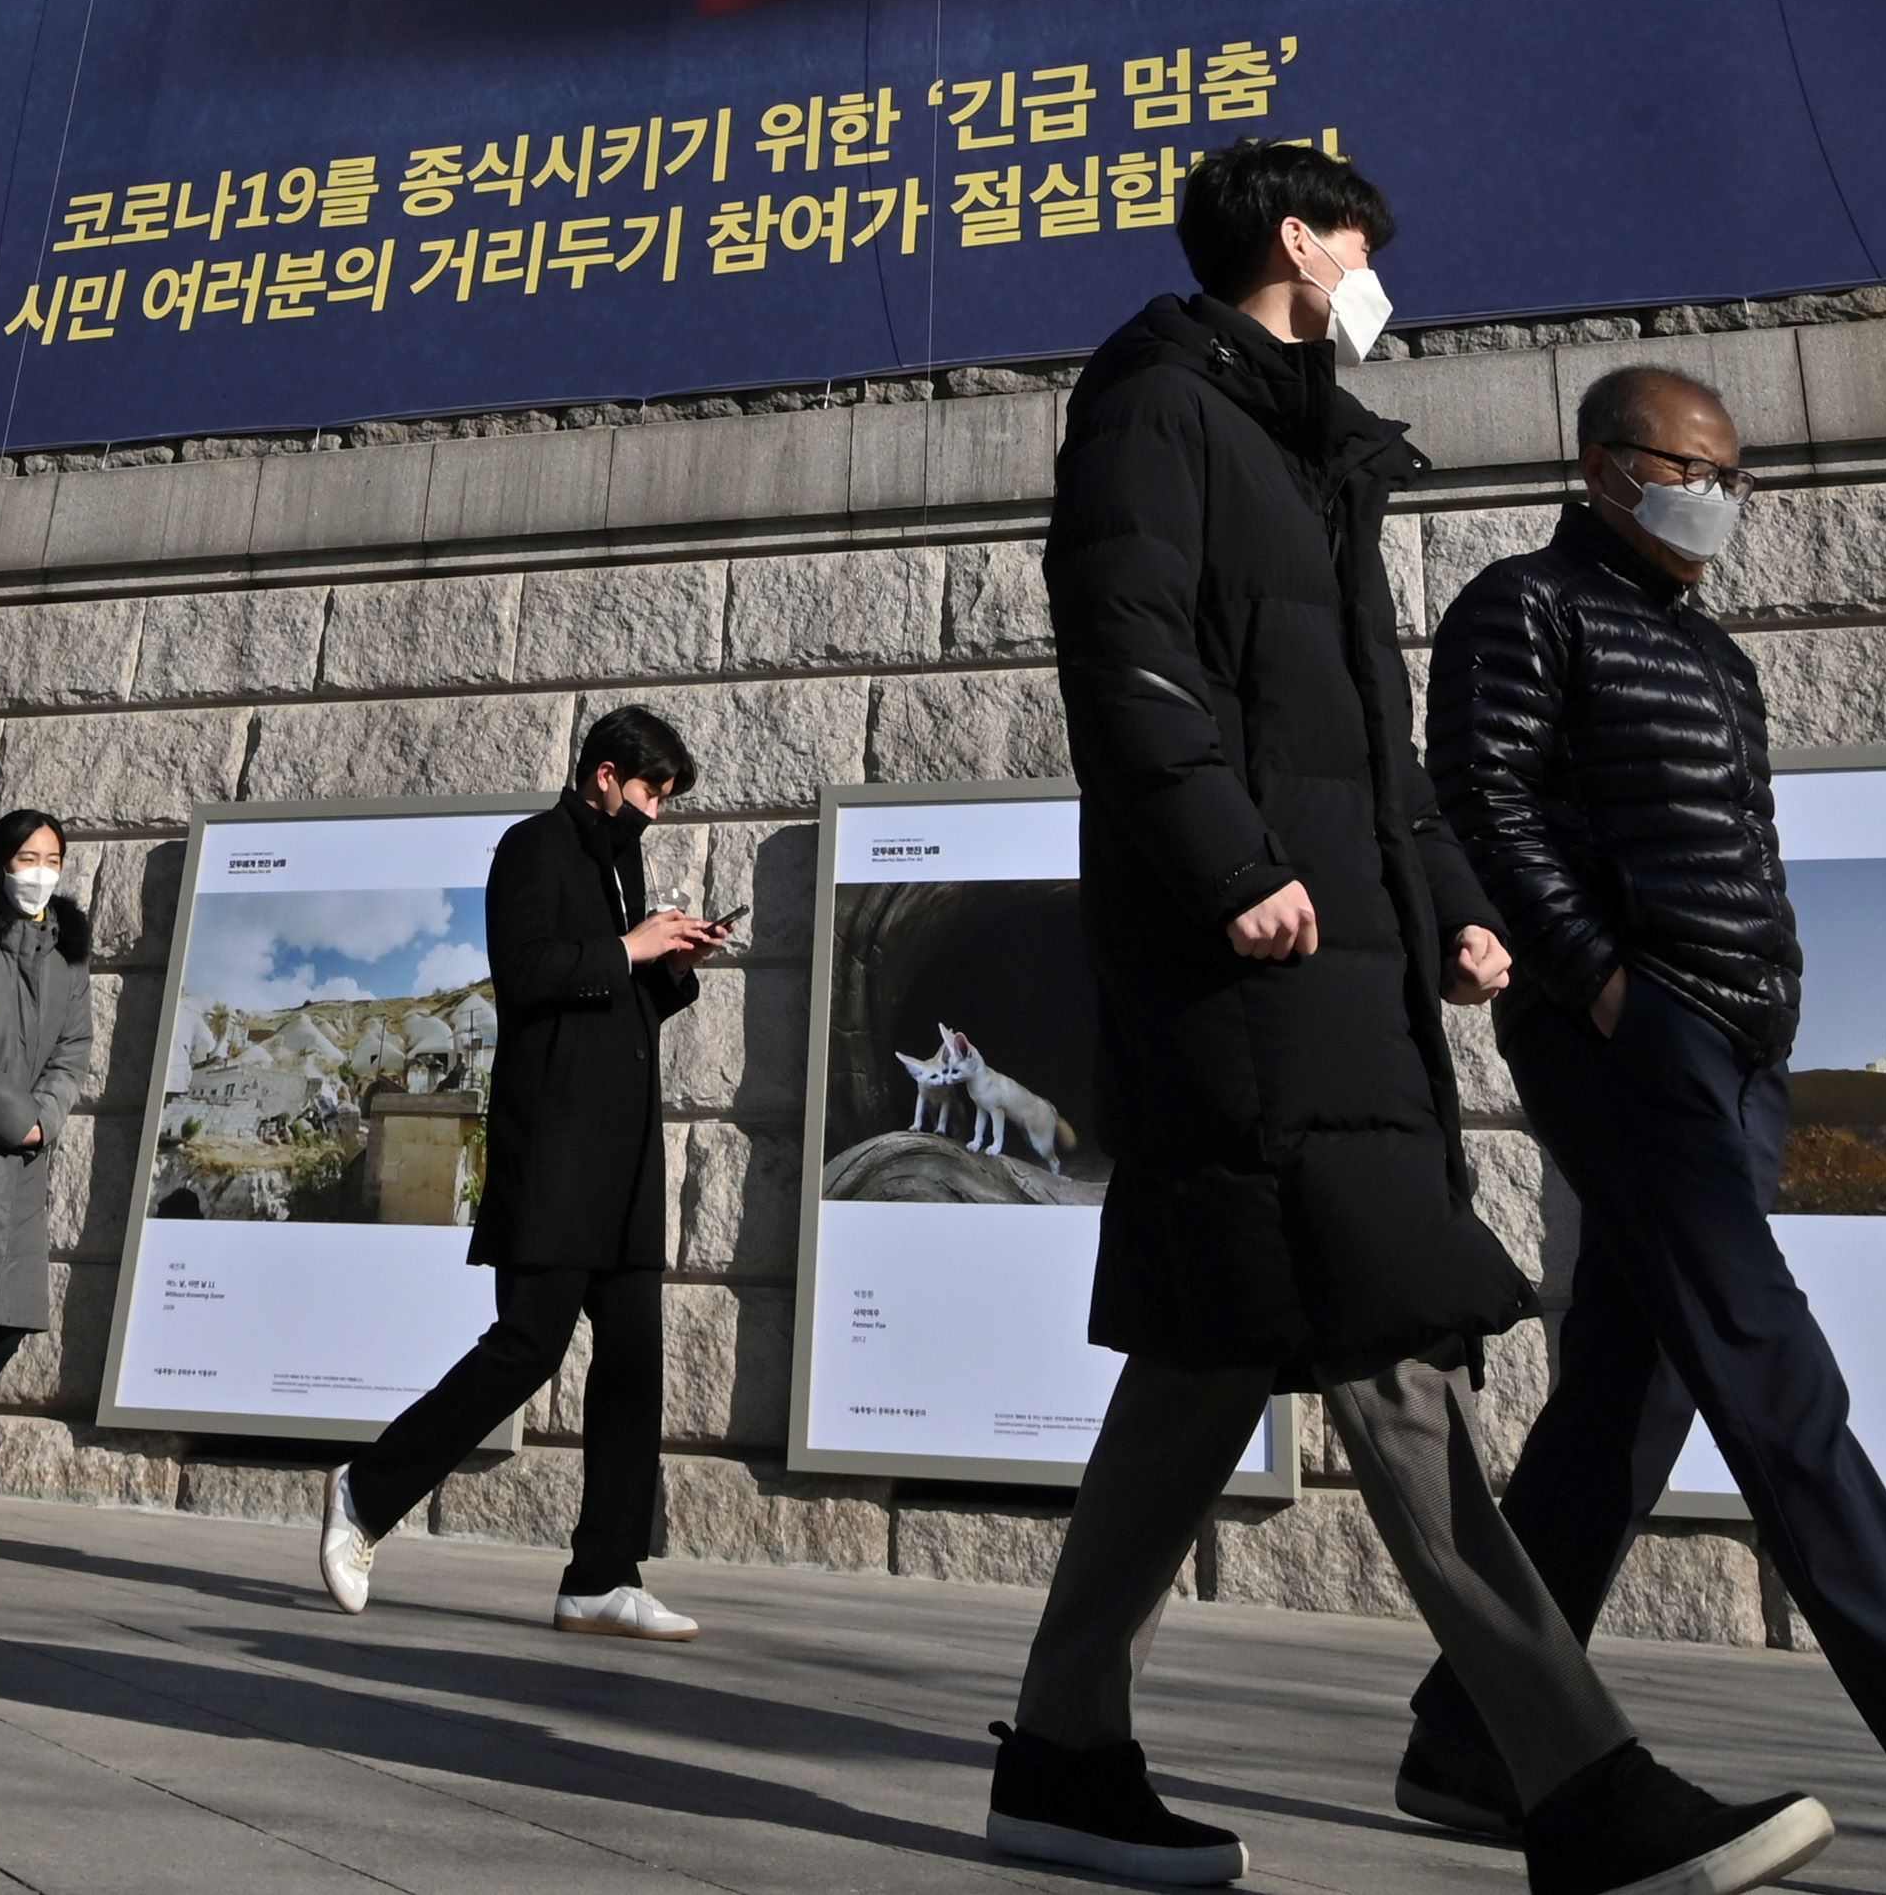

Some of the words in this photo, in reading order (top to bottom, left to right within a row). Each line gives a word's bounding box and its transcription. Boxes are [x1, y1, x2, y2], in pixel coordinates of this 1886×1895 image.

[6, 270, 126, 345] 시민
[144, 239, 395, 329] 여러분의
[411, 207, 682, 301] 거리두기
[709, 178, 929, 273] 참여가
[951, 128, 1351, 249] 절실합
[55, 156, 379, 251] 코로나19를
[401, 108, 731, 216] 종식시키기
[756, 88, 901, 172] 위한
[927, 64, 1097, 151] ‘긴급
[1124, 37, 1297, 129] 멈춤’
